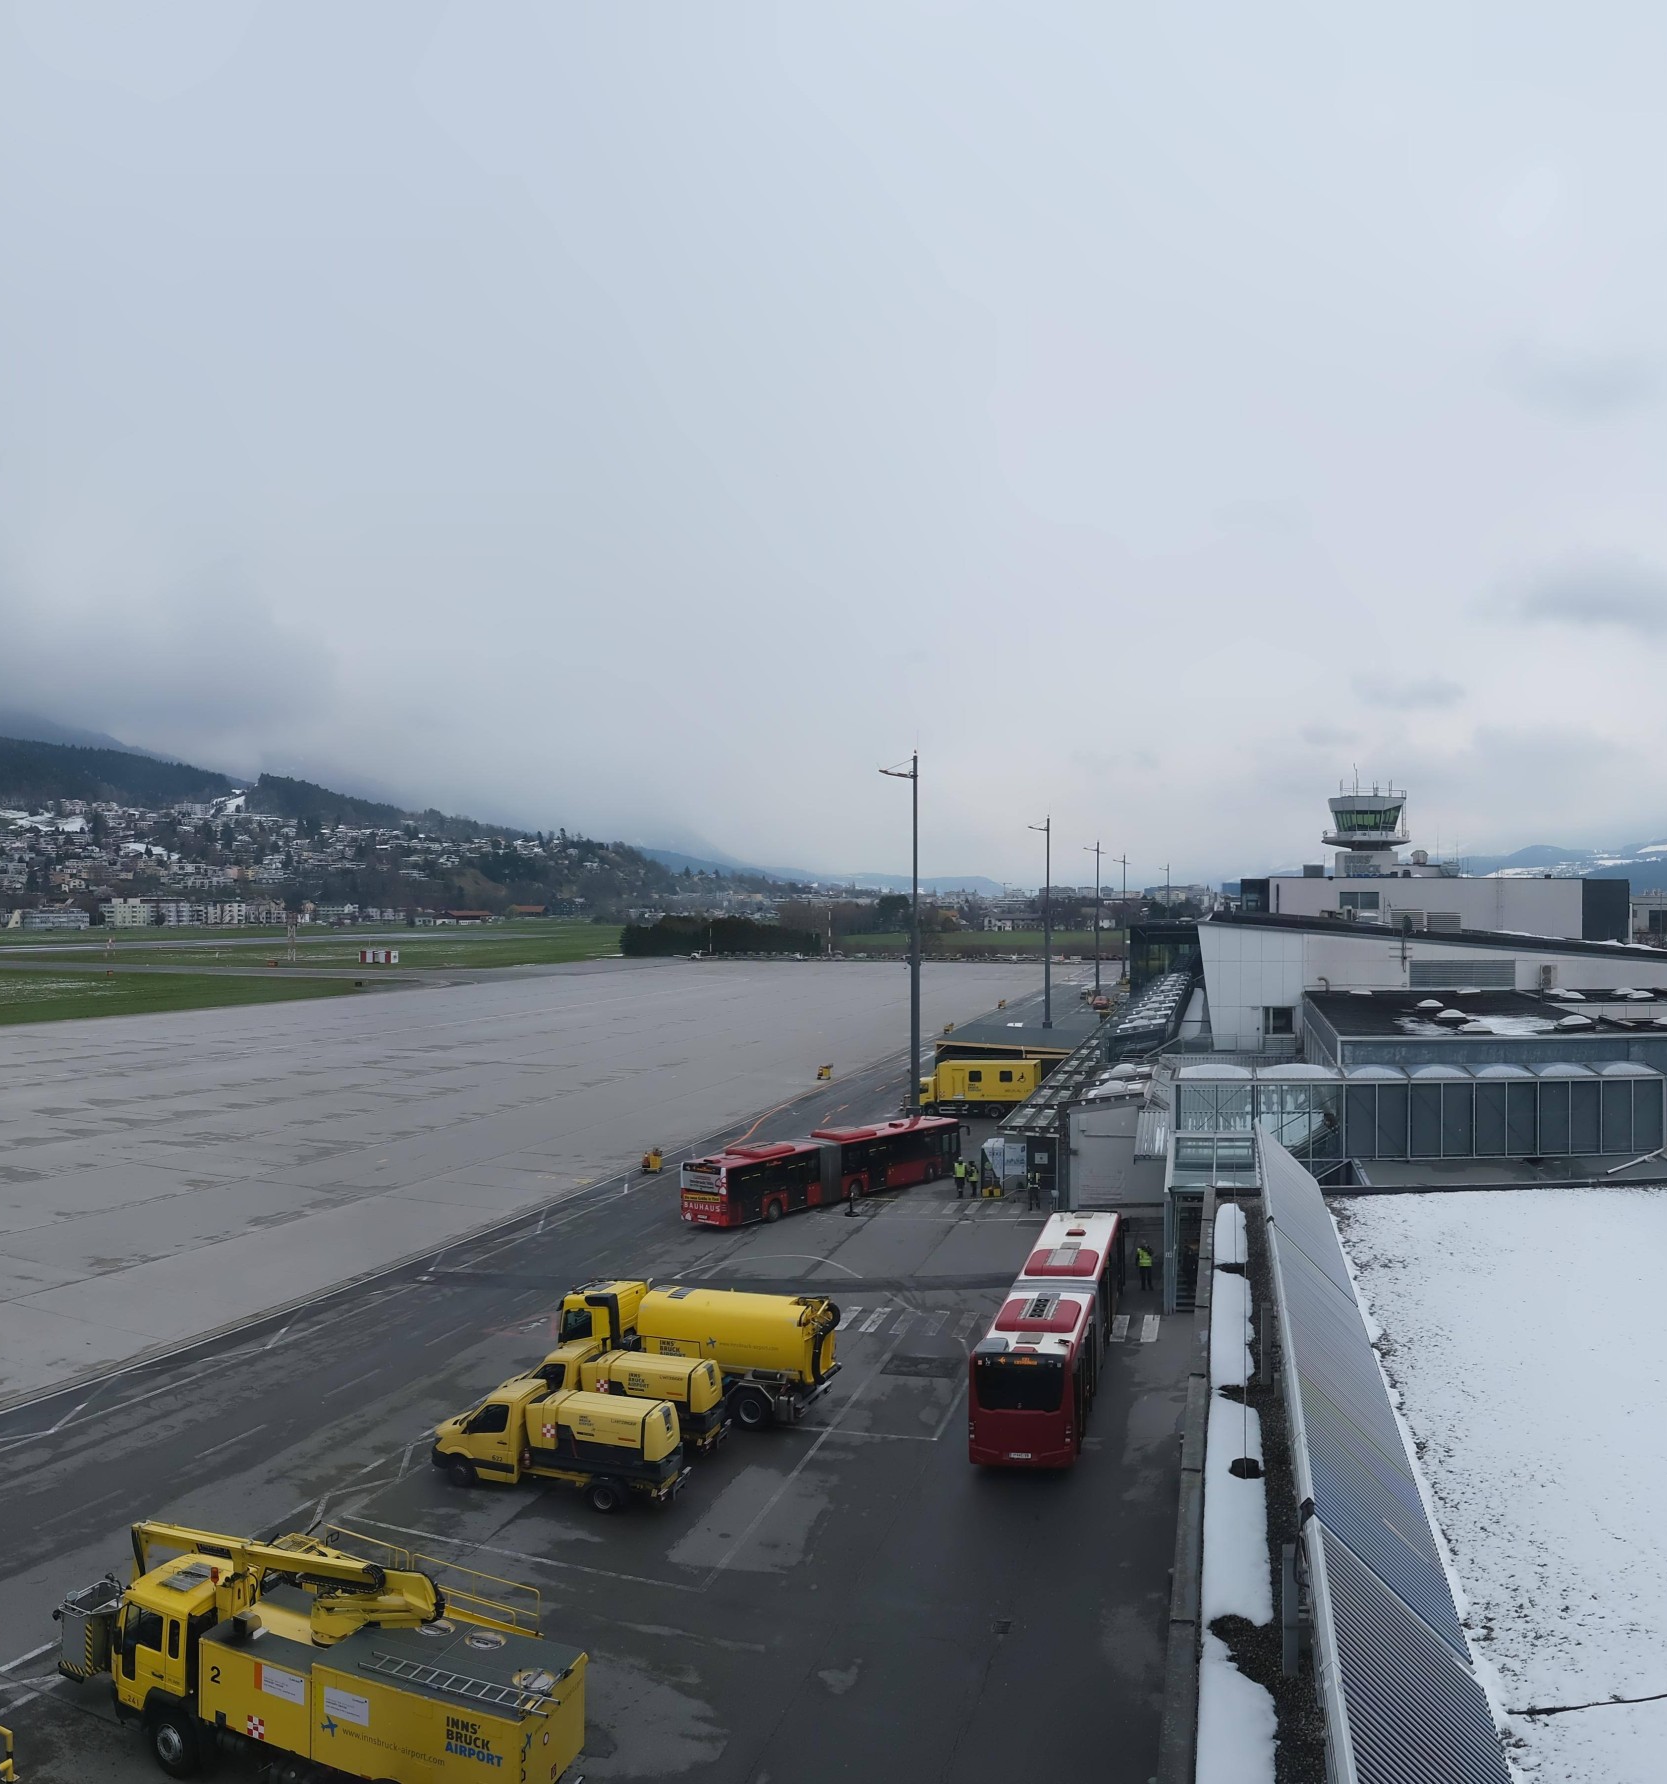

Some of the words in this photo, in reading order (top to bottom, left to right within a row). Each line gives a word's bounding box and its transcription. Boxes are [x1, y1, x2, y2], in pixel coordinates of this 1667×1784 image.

[684, 1202, 720, 1213] BAUHAUS
[210, 1666, 221, 1684] 2
[342, 1727, 446, 1767] www.innsbruck-airport.com
[446, 1728, 490, 1751] BRUCK
[445, 1741, 503, 1768] AIRPORT
